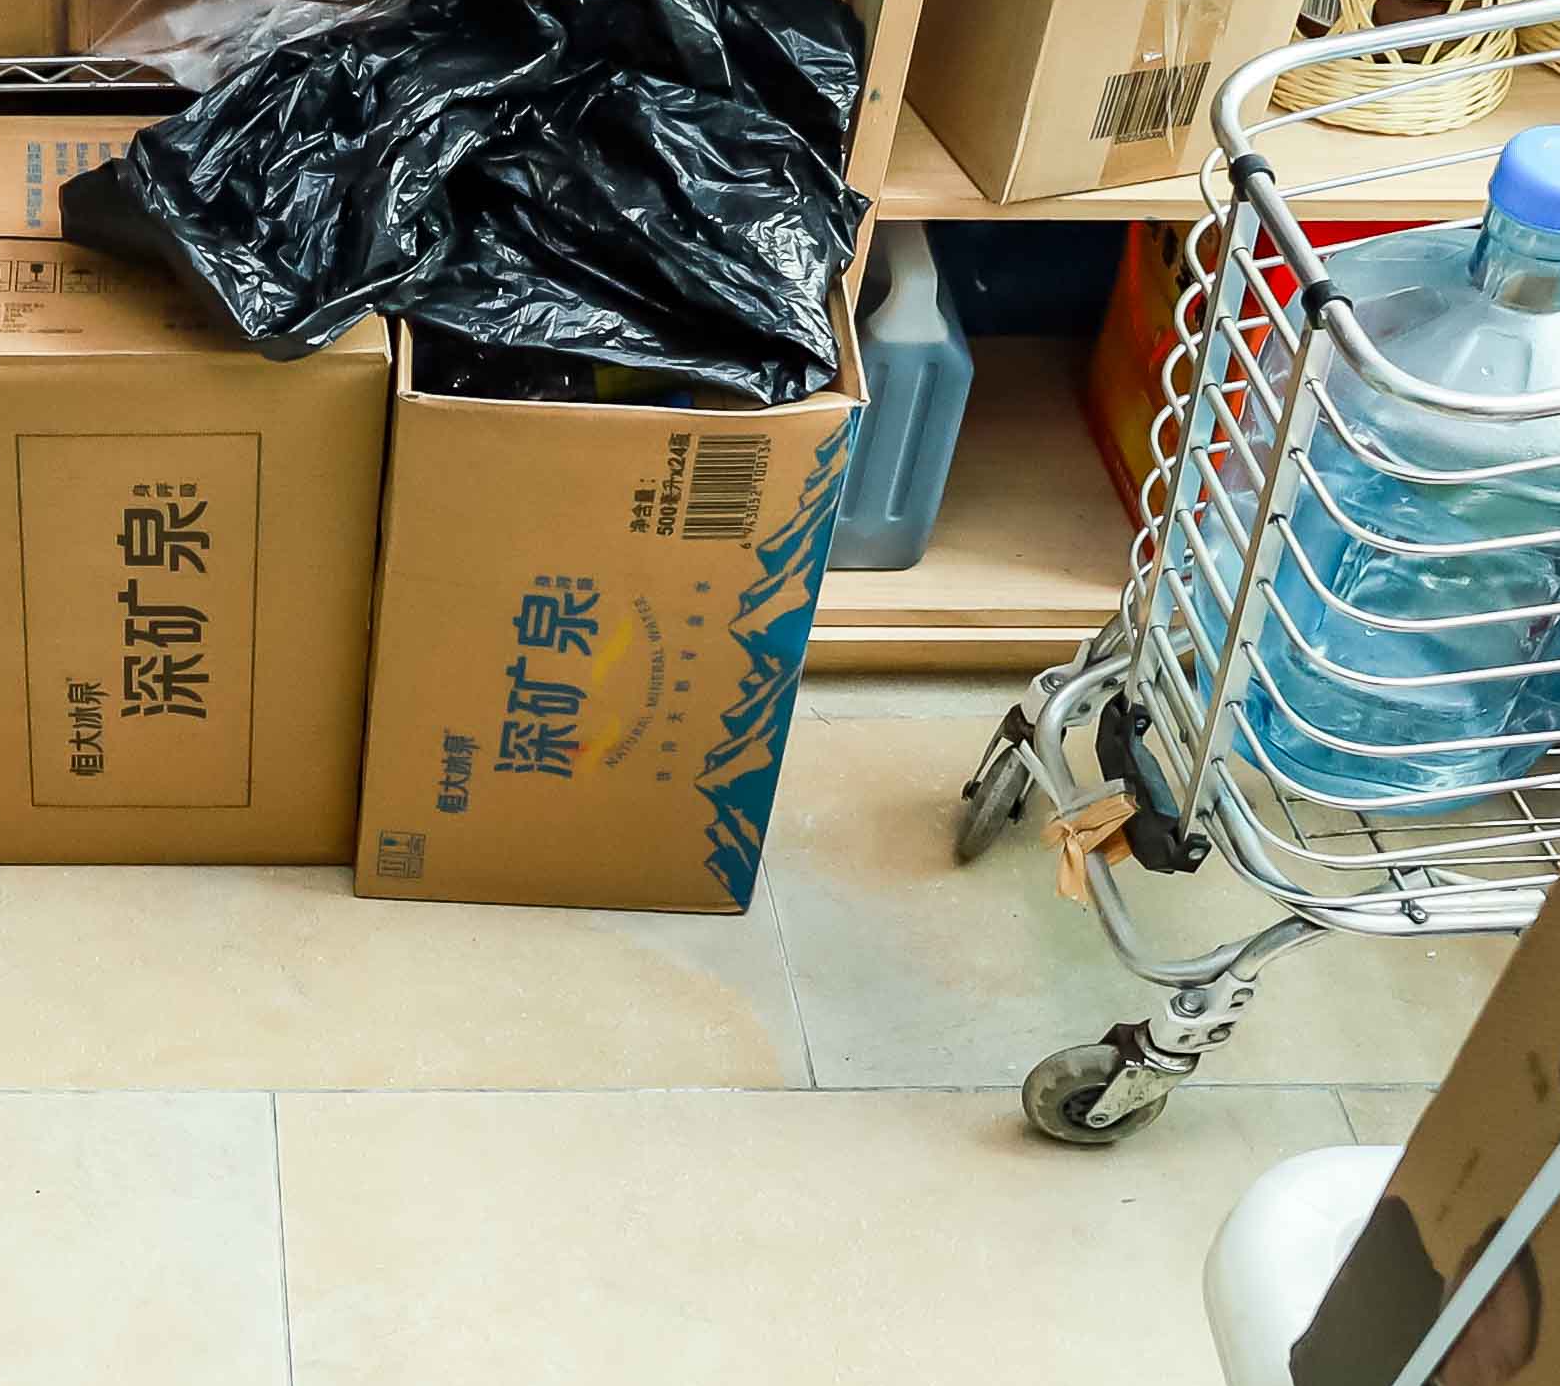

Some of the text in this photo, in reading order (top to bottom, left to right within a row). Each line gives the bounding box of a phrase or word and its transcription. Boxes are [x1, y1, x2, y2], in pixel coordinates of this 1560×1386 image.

[116, 501, 210, 719] 深矿泉
[494, 592, 600, 779] 深矿泉
[604, 596, 666, 768] NATURAL MINERAL WATER
[68, 681, 110, 777] 恒大冰泉
[436, 733, 480, 813] 恒大冰泉
